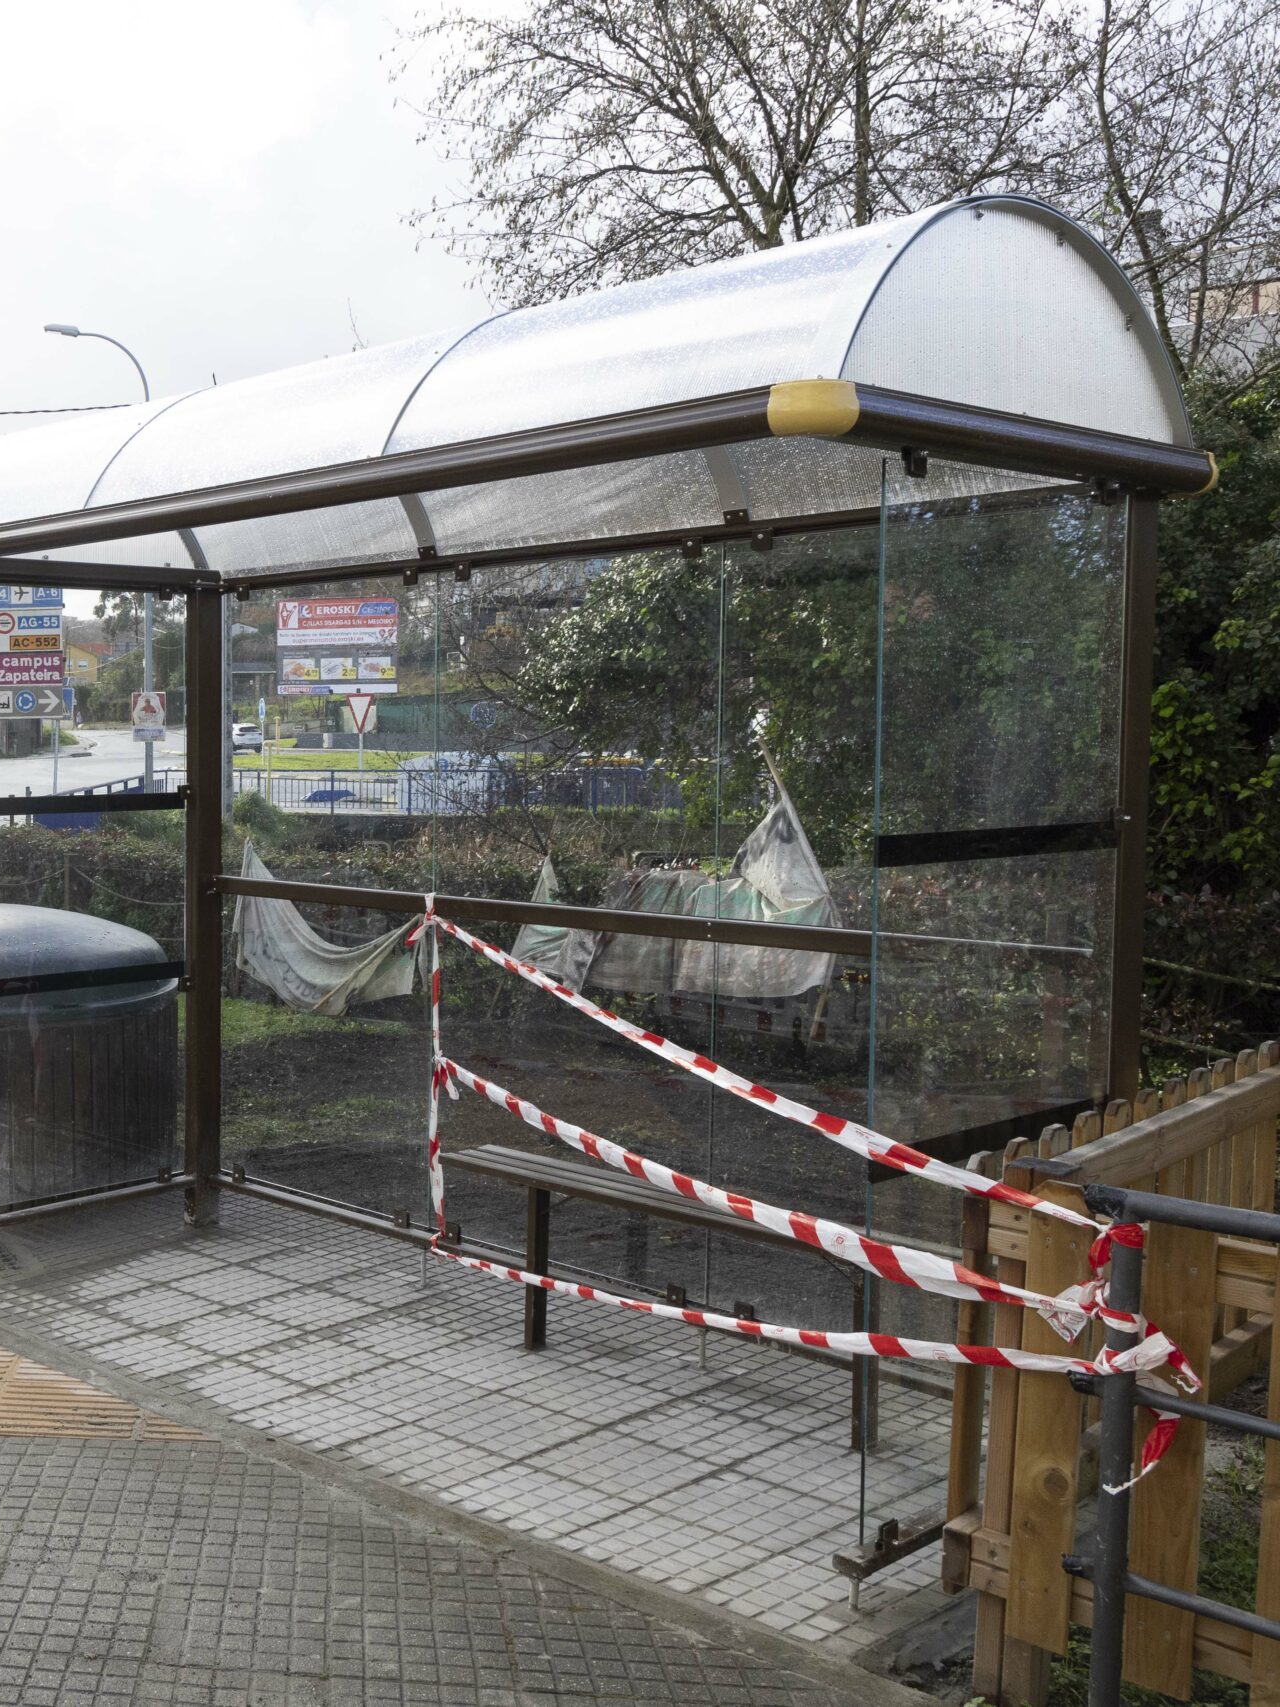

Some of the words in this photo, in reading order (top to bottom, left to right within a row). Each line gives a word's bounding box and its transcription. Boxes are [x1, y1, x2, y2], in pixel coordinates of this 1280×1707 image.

[36, 587, 58, 598] A-6
[316, 605, 355, 615] EROSKI
[20, 616, 59, 628] AG-55
[12, 637, 58, 649] AC-552
[2, 656, 61, 668] campus
